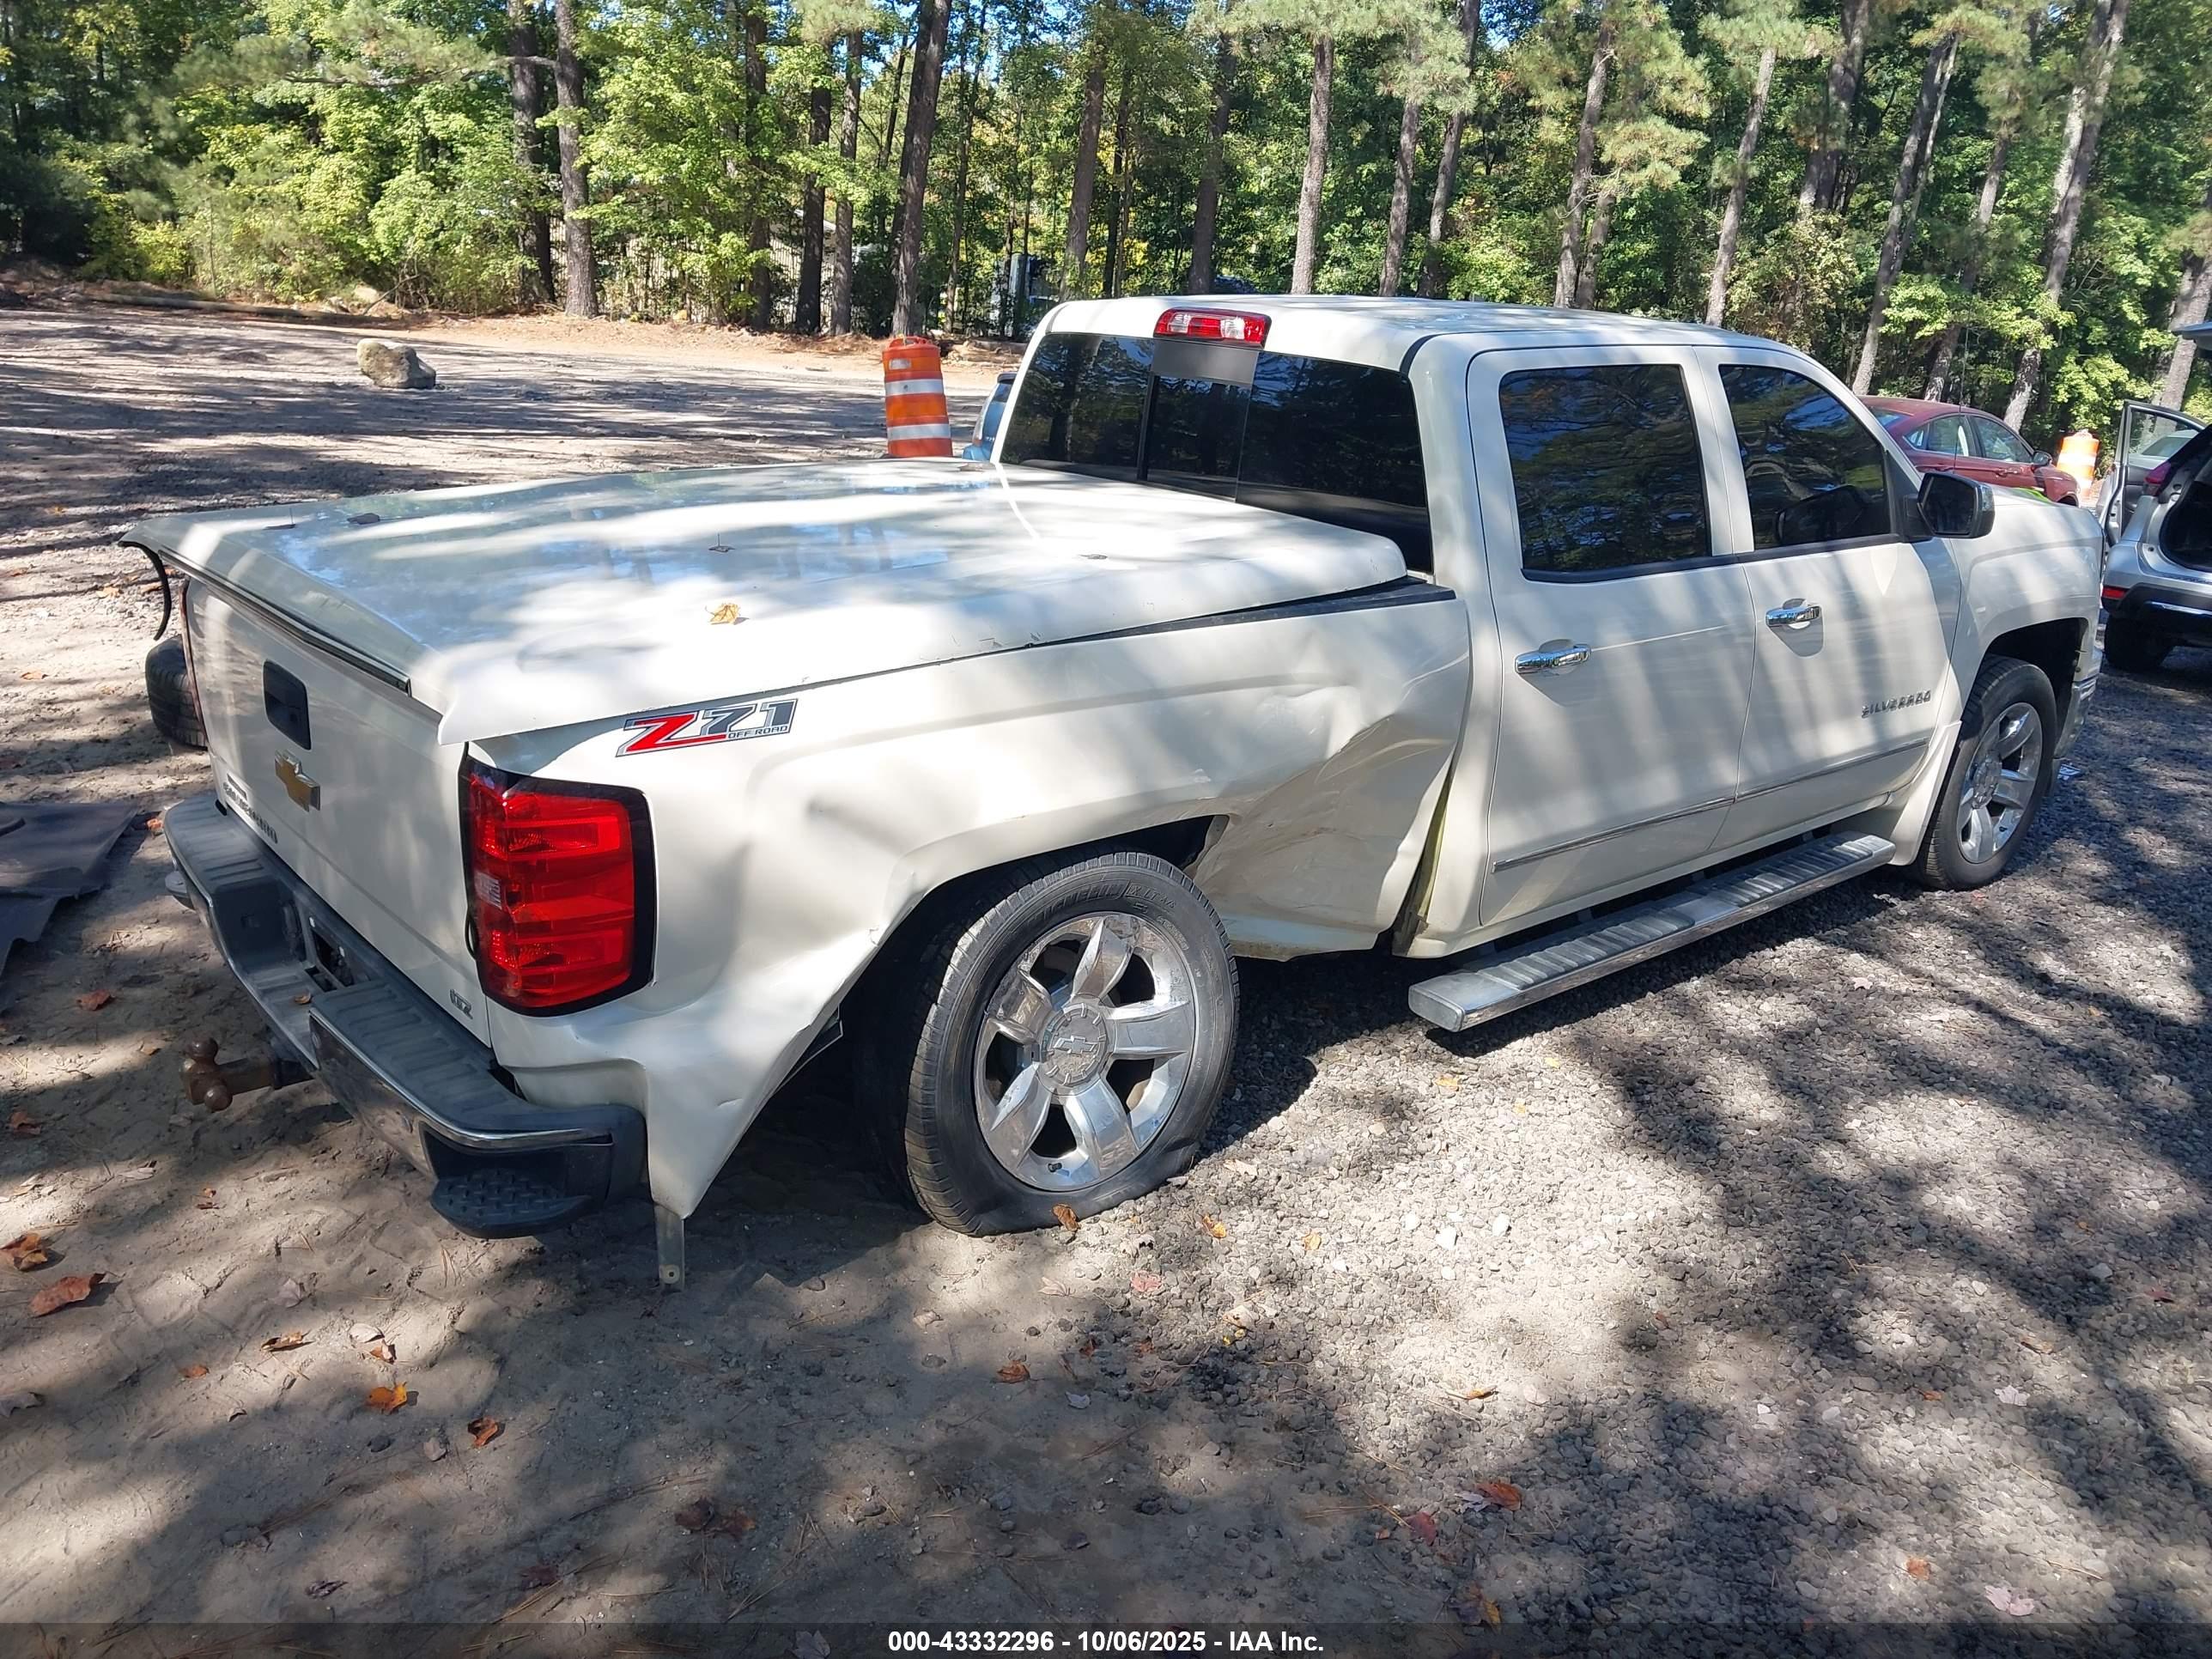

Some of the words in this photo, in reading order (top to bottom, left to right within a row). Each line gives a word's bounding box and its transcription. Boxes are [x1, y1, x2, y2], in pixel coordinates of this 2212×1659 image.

[1861, 690, 1931, 719] SILVERADO
[616, 698, 799, 757] Z71
[727, 730, 751, 739] OFF
[755, 726, 788, 735] ROAD
[449, 988, 474, 1020] LTZ
